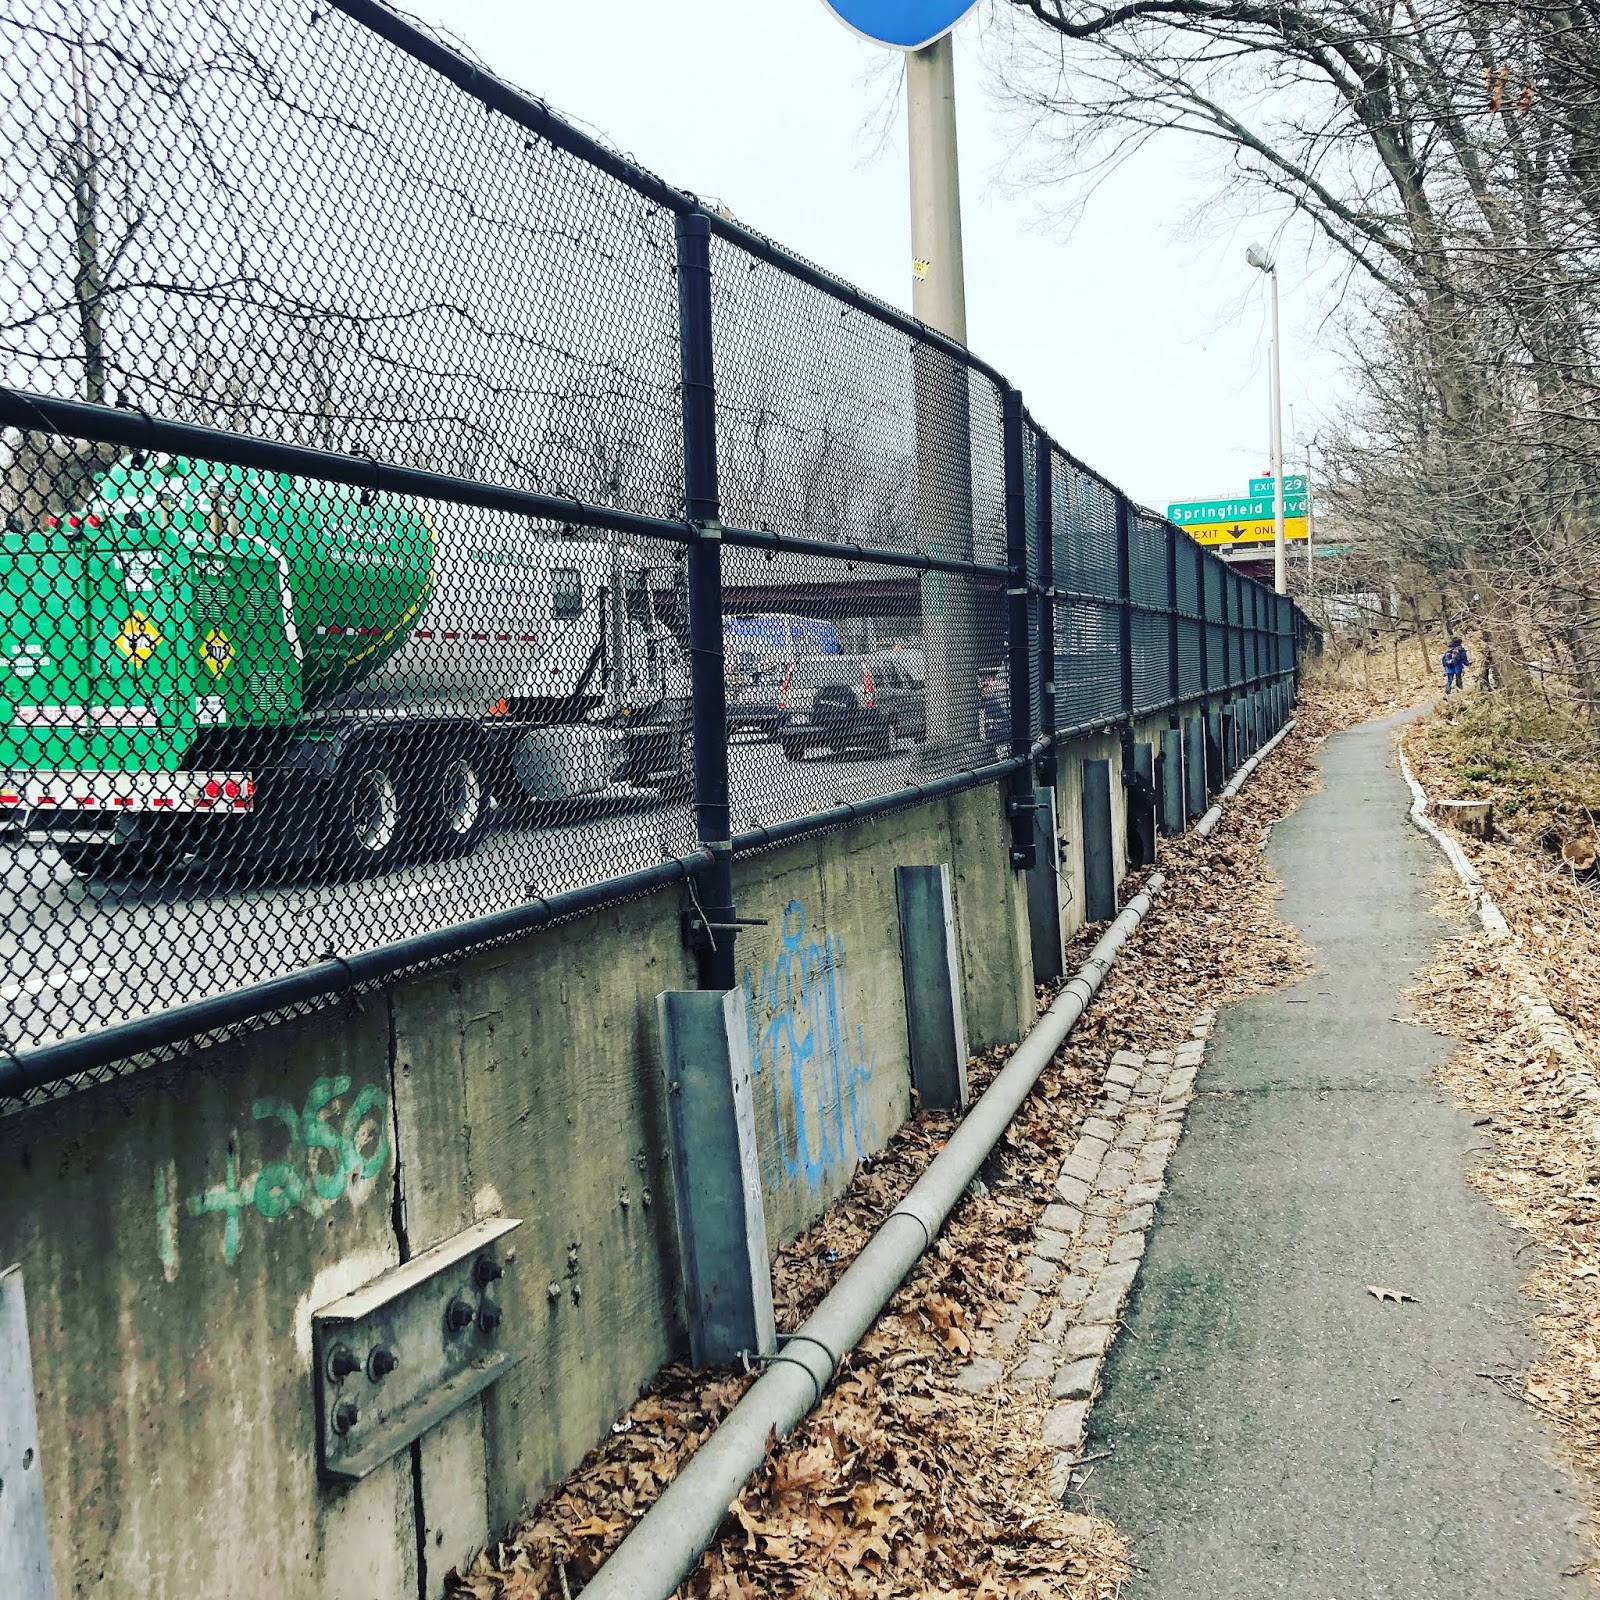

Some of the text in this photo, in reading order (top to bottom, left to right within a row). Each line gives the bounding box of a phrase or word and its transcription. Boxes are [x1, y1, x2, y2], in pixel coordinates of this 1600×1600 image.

[1254, 479, 1302, 492] EXIT 29
[1173, 501, 1263, 521] Springfield
[1193, 525, 1286, 540] EXIT ONL
